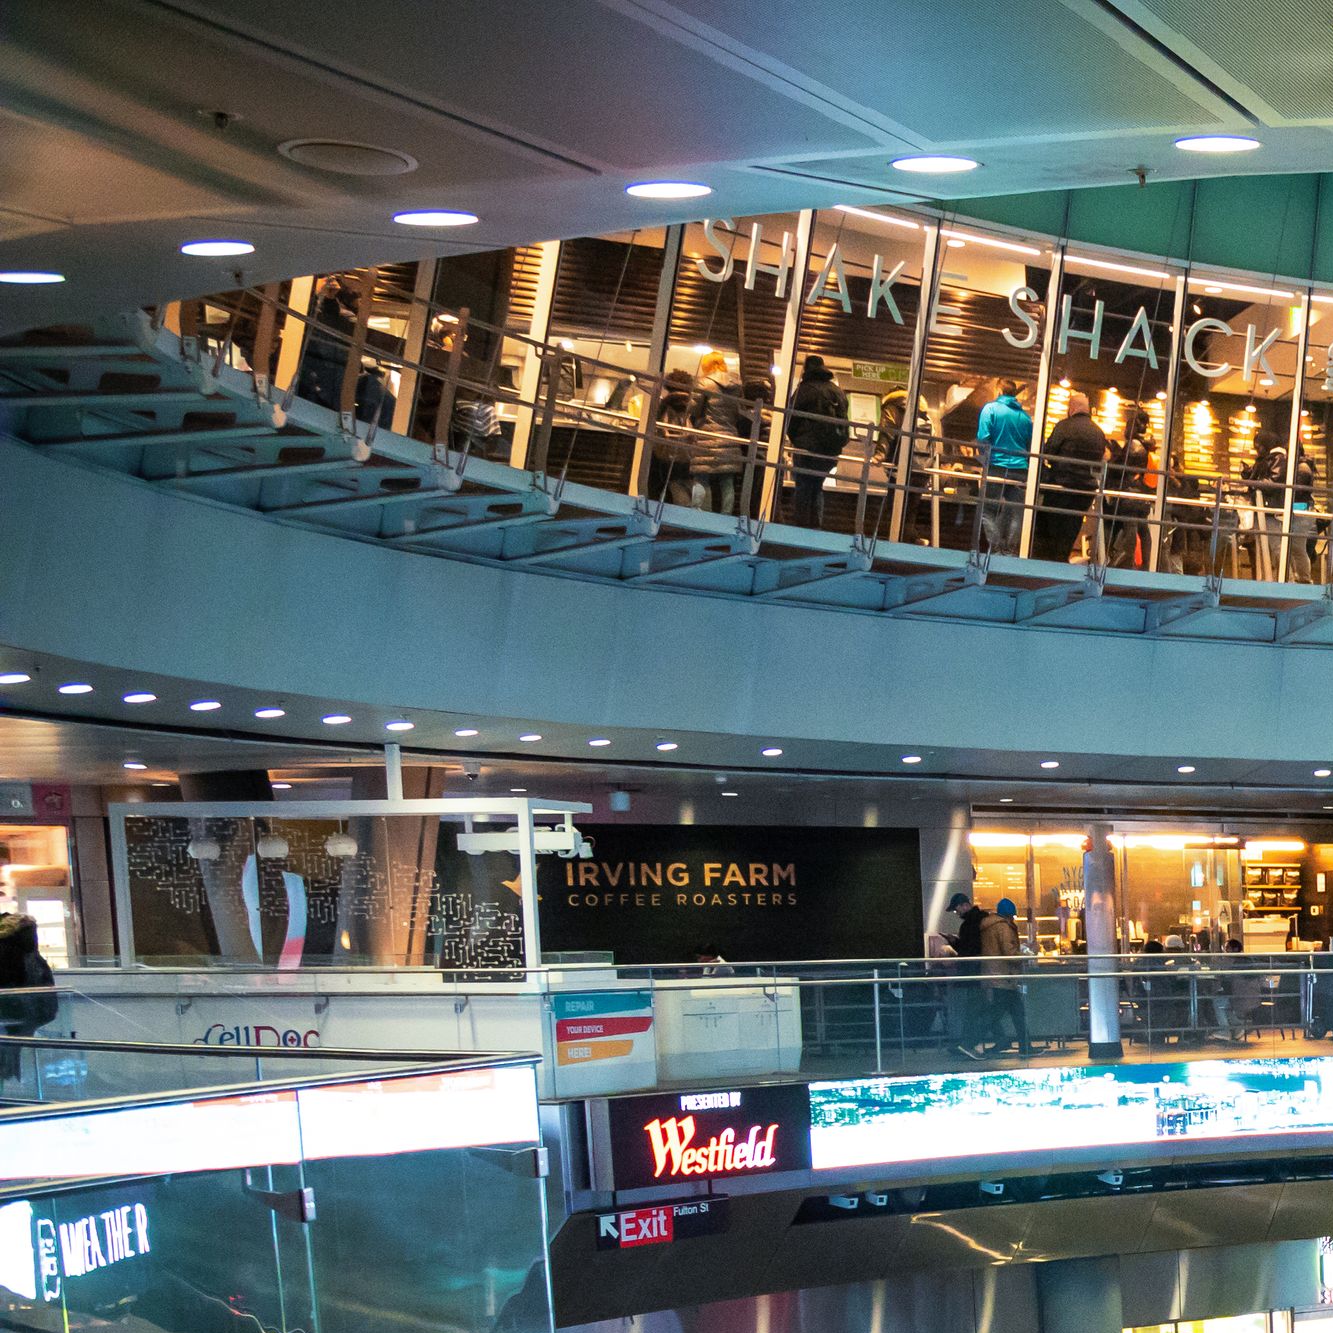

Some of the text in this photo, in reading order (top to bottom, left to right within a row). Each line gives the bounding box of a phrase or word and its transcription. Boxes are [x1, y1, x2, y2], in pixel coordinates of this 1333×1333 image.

[1001, 286, 1282, 386] SHACK
[566, 862, 797, 887] IRVING FARM
[568, 893, 797, 906] COFFEE ROASTERS
[565, 1000, 595, 1012] REPAIR
[566, 1025, 604, 1034] YOUR DEVICE
[643, 1115, 779, 1178] Westfield
[619, 1203, 709, 1242] Exit Fulton St
